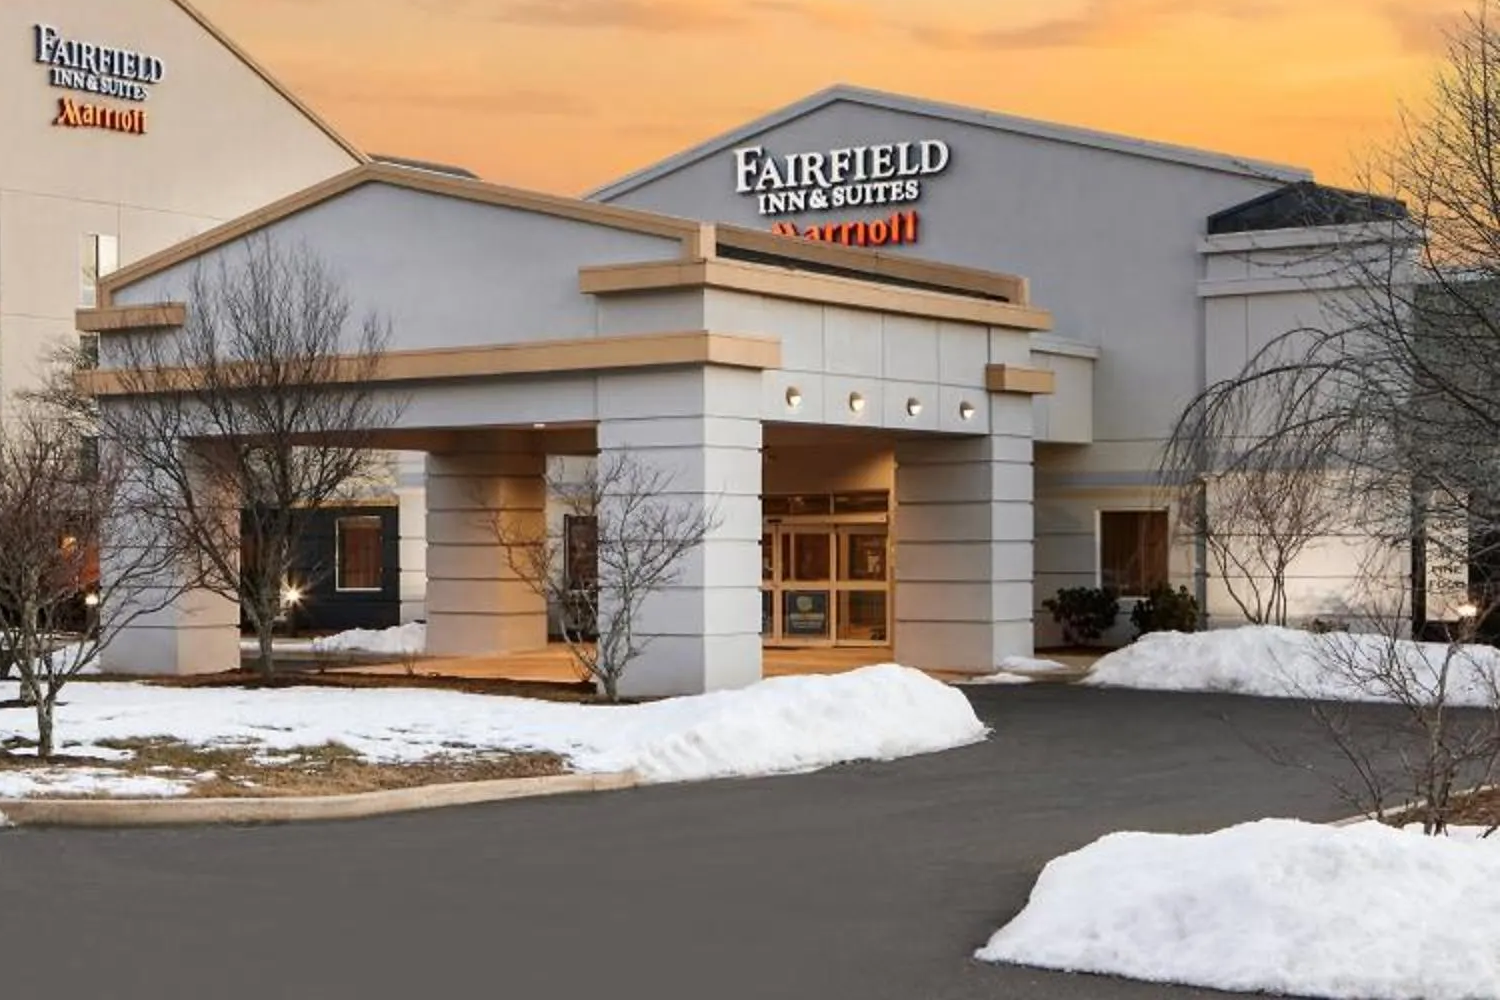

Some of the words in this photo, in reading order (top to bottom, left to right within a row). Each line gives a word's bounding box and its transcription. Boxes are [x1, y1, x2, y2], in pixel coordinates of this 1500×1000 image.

[35, 23, 165, 84] FAIRFIELD
[51, 67, 85, 90] INN
[101, 76, 149, 100] SUITES
[54, 96, 148, 134] Marriott
[734, 139, 950, 194] FAIRFIELD
[759, 190, 806, 214] INN
[809, 187, 829, 210] &
[832, 179, 920, 208] SUITES
